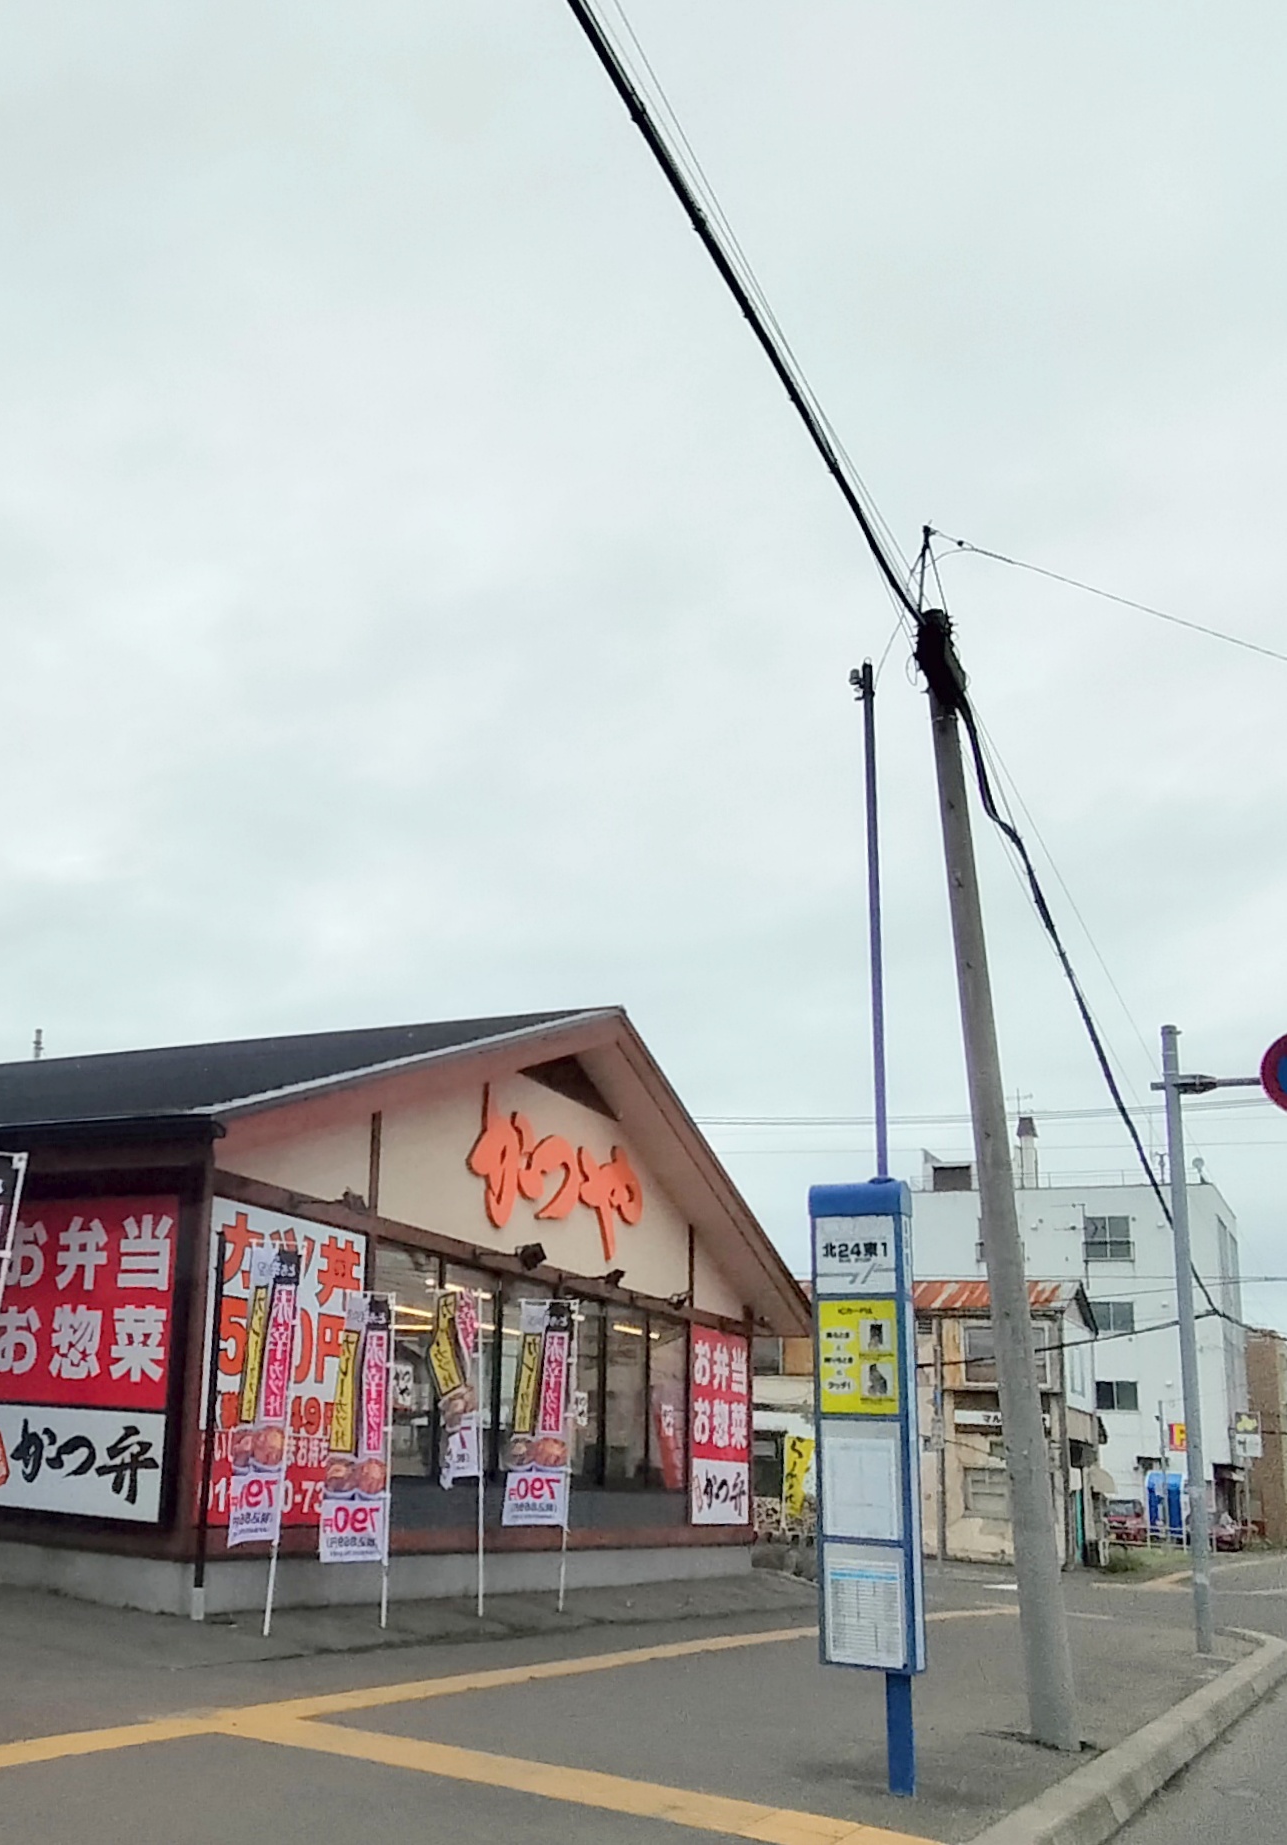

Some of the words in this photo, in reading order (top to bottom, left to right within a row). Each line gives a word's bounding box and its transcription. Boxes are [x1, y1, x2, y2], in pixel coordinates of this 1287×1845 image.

[467, 1082, 643, 1262] かつや
[6, 1215, 174, 1292] お弁当
[822, 1242, 888, 1258] 北24東1
[693, 1340, 748, 1395] お弁当
[693, 1397, 748, 1450] お惣菜
[10, 1418, 160, 1505] かつ弁
[703, 1469, 747, 1518] かつ弁
